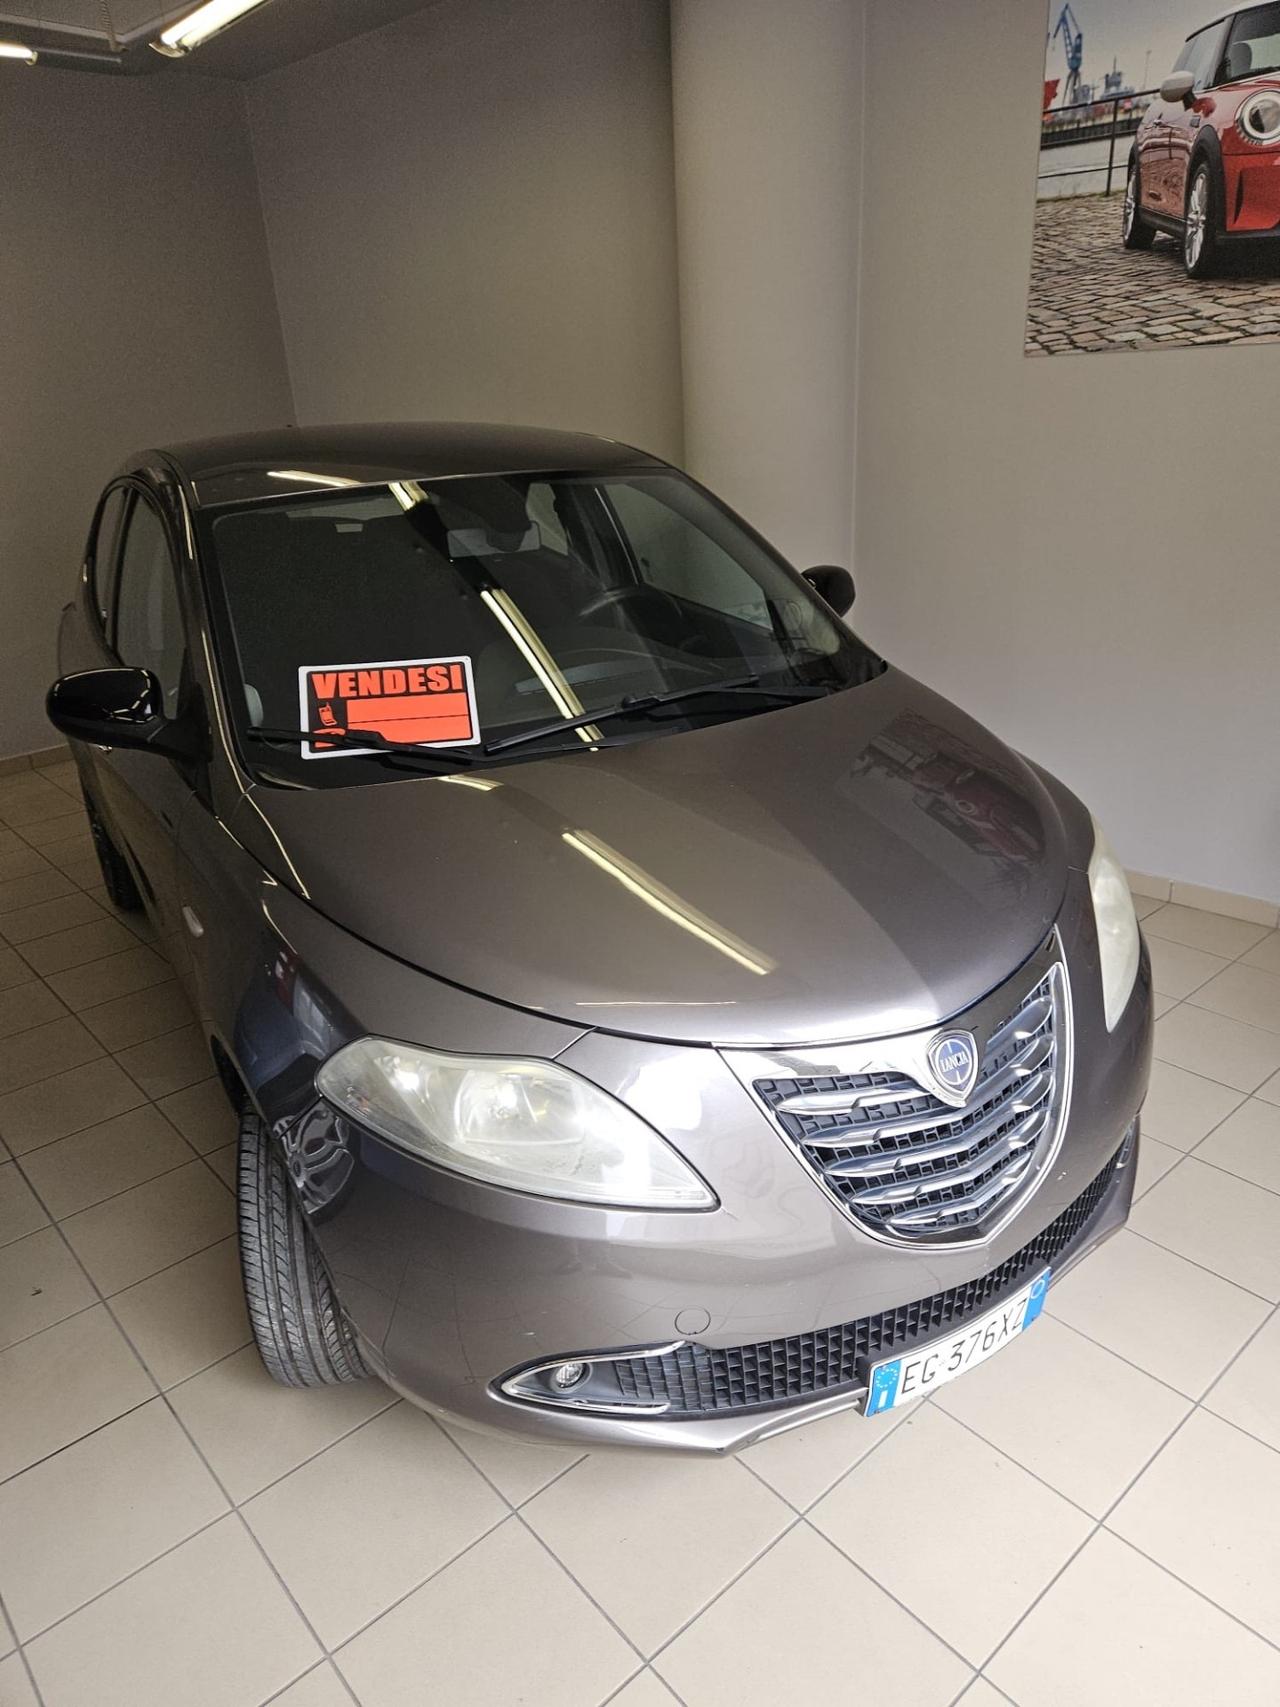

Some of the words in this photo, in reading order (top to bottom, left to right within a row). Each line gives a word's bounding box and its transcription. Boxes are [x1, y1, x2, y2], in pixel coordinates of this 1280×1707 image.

[311, 664, 463, 699] VENDESI
[940, 1051, 969, 1073] LANCIA
[901, 1353, 939, 1394] EG
